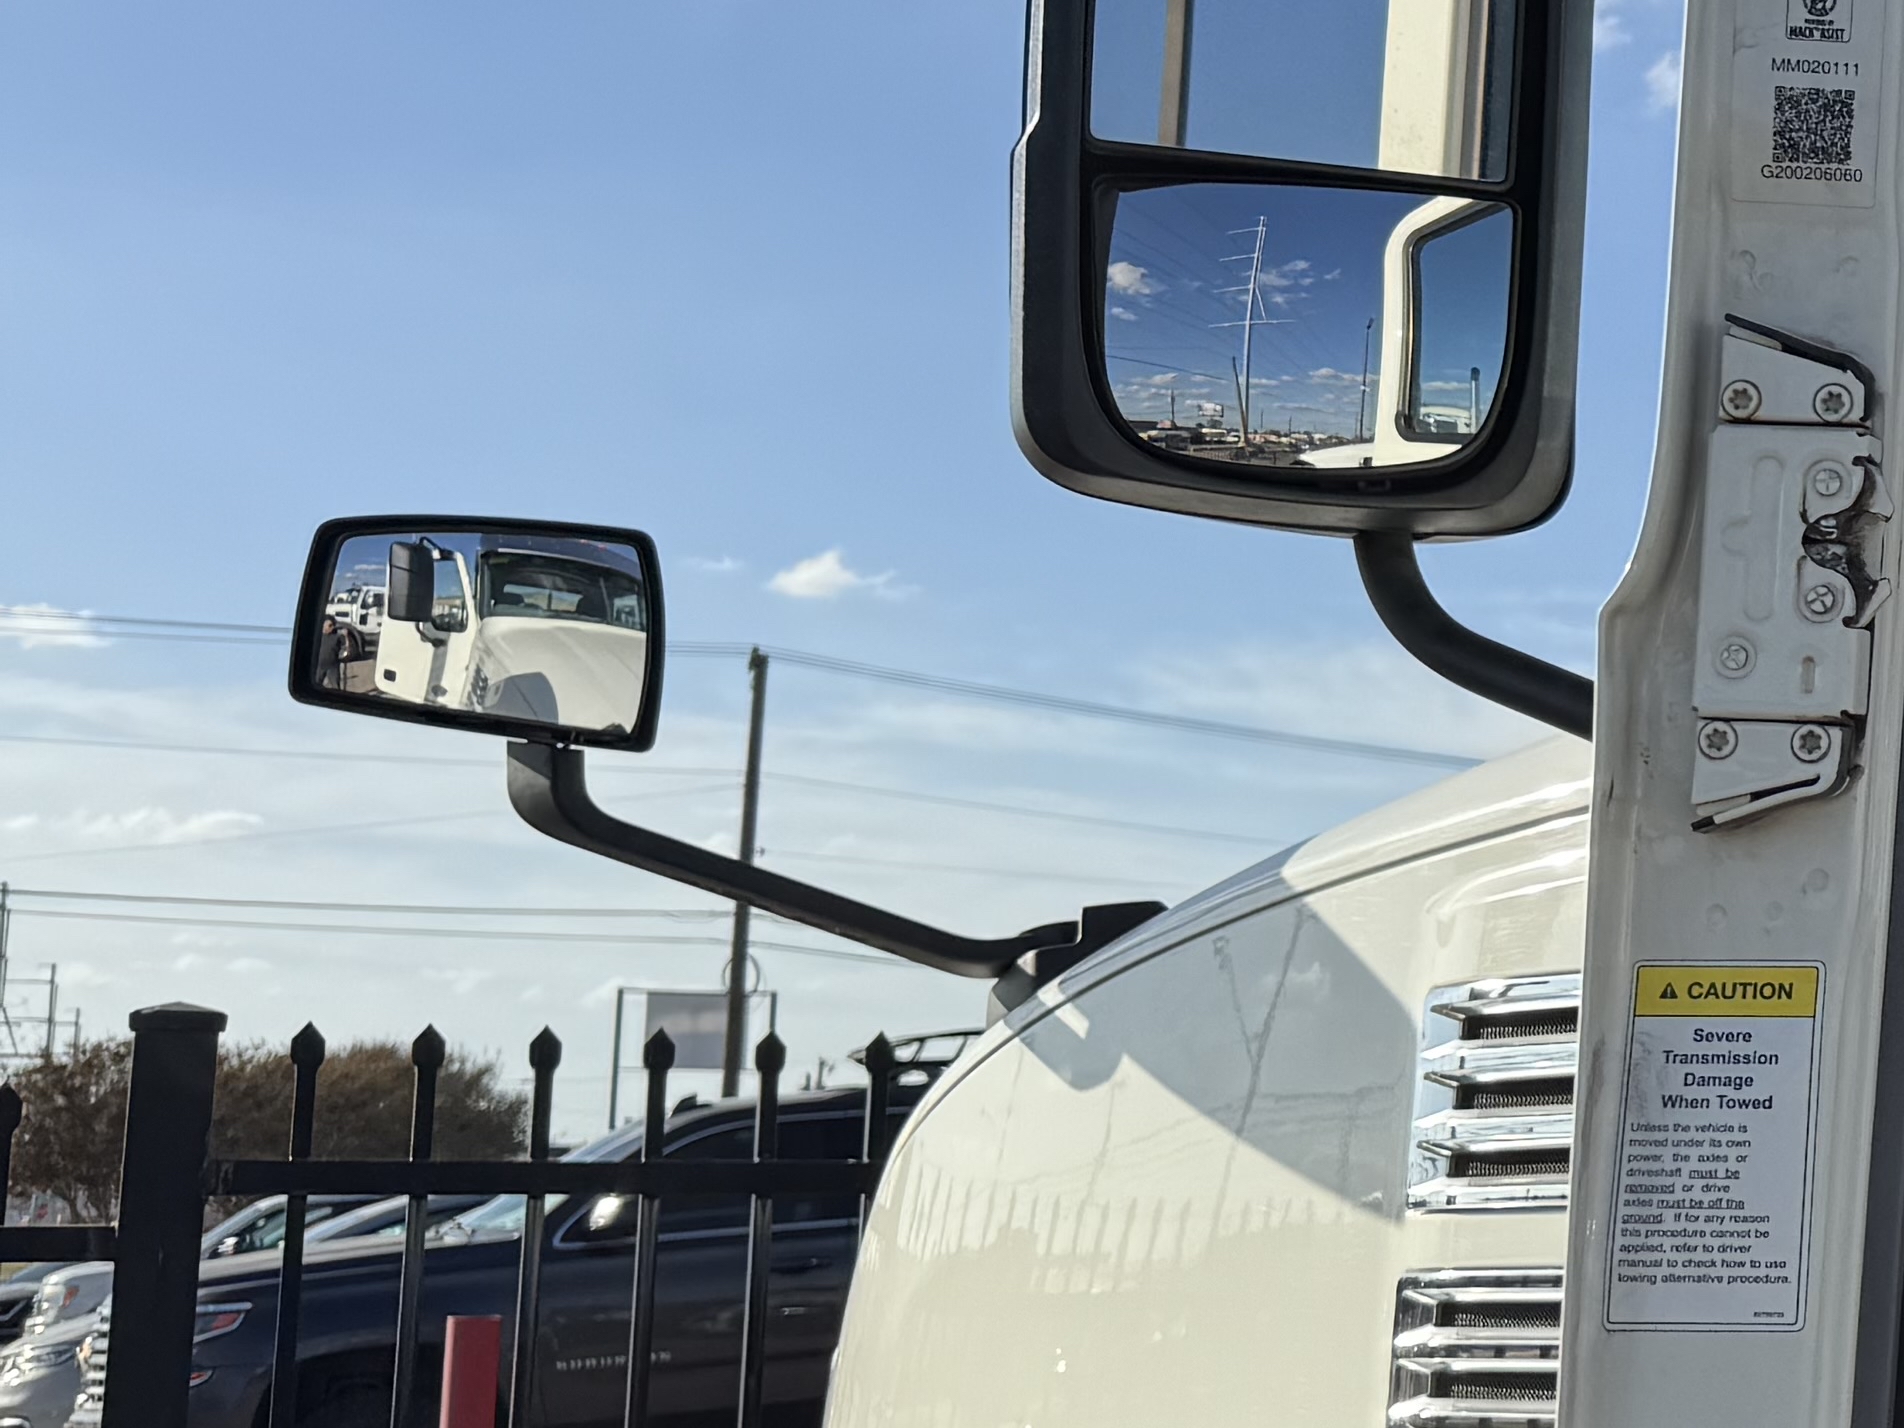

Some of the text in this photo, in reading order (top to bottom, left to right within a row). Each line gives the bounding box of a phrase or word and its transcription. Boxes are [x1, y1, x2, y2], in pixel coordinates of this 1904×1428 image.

[1771, 58, 1860, 77] MM020111
[1686, 980, 1793, 1000] CAUTION
[1692, 1028, 1752, 1042] Severe
[1661, 1049, 1779, 1065] Transmission
[1682, 1072, 1754, 1088] Damage
[1659, 1094, 1773, 1110] When Towed
[1629, 1122, 1748, 1133] Unless the vehicle is
[1628, 1137, 1751, 1148] moved under its own
[1671, 1152, 1690, 1163] the
[1734, 1153, 1748, 1164] or
[1625, 1166, 1740, 1177] driveshaft must be
[1624, 1182, 1730, 1192] removed or drive
[1656, 1197, 1686, 1206] must
[1688, 1197, 1704, 1207] be
[1707, 1197, 1723, 1207] off
[1725, 1198, 1745, 1207] the
[1673, 1212, 1681, 1223] If
[1683, 1212, 1700, 1223] for
[1703, 1213, 1725, 1224] any
[1728, 1213, 1770, 1224] reason
[1620, 1227, 1770, 1238] this procedure cannot be
[1669, 1242, 1699, 1254] refer
[1701, 1243, 1714, 1254] to
[1716, 1243, 1752, 1254] driver
[1617, 1257, 1786, 1269] manual to check how to use
[1616, 1272, 1657, 1284] towing
[1660, 1272, 1724, 1285] alternative
